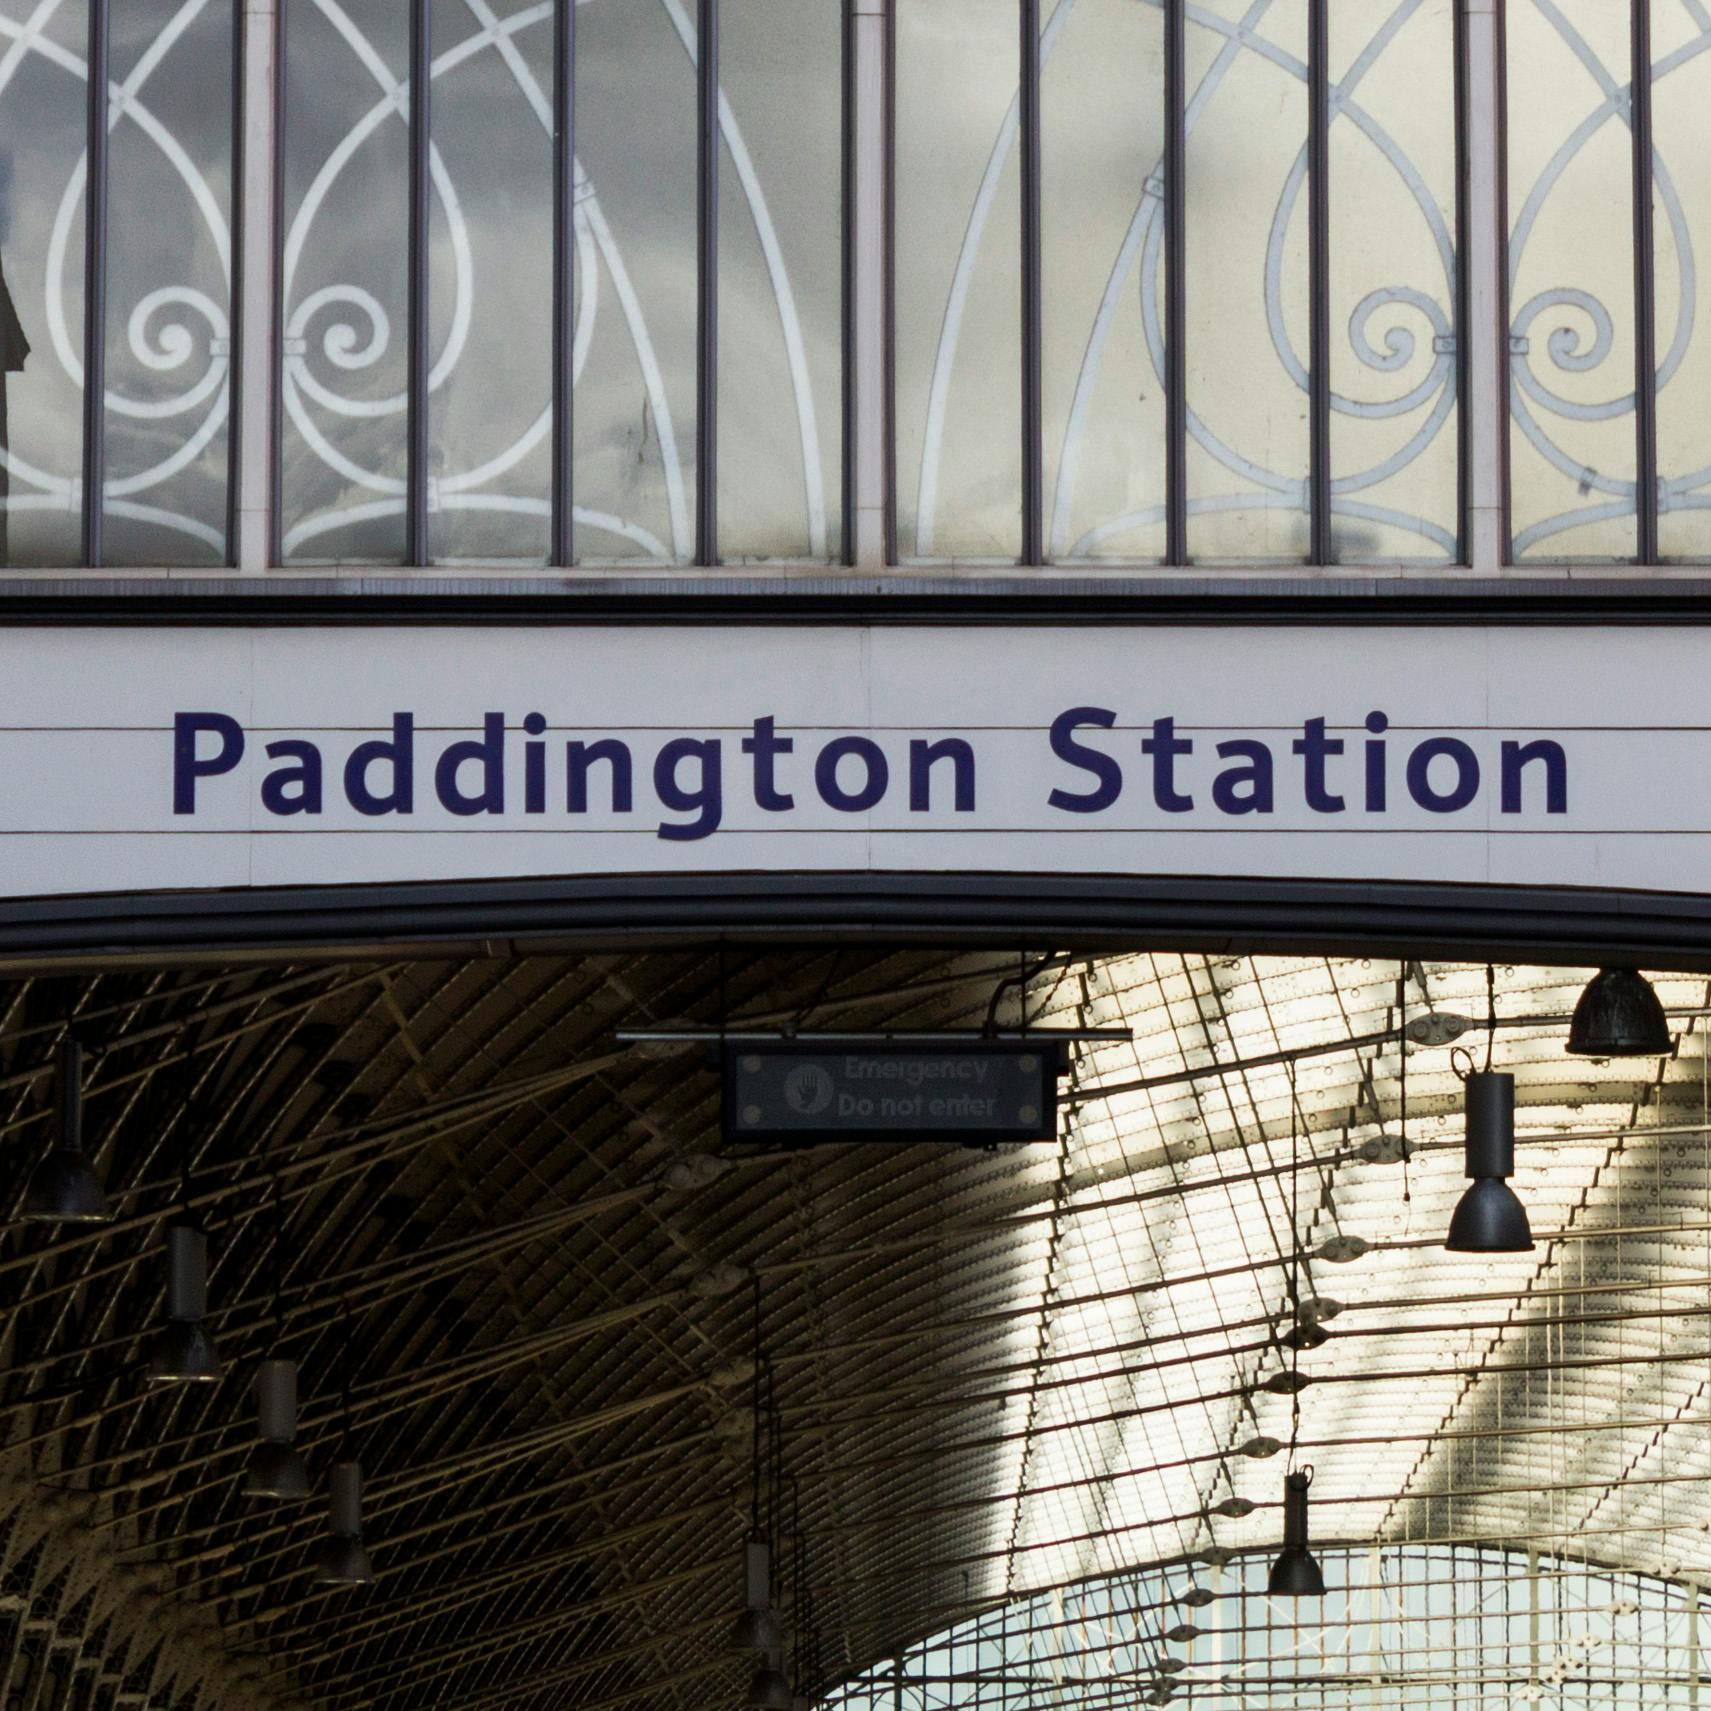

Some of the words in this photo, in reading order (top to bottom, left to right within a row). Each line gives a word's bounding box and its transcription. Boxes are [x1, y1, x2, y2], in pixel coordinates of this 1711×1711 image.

[174, 710, 978, 840] Paddington
[1048, 707, 1569, 814] Station
[844, 1055, 990, 1087] Emergency
[838, 1093, 875, 1118] Do
[880, 1093, 923, 1118] not
[928, 1093, 998, 1118] enter
